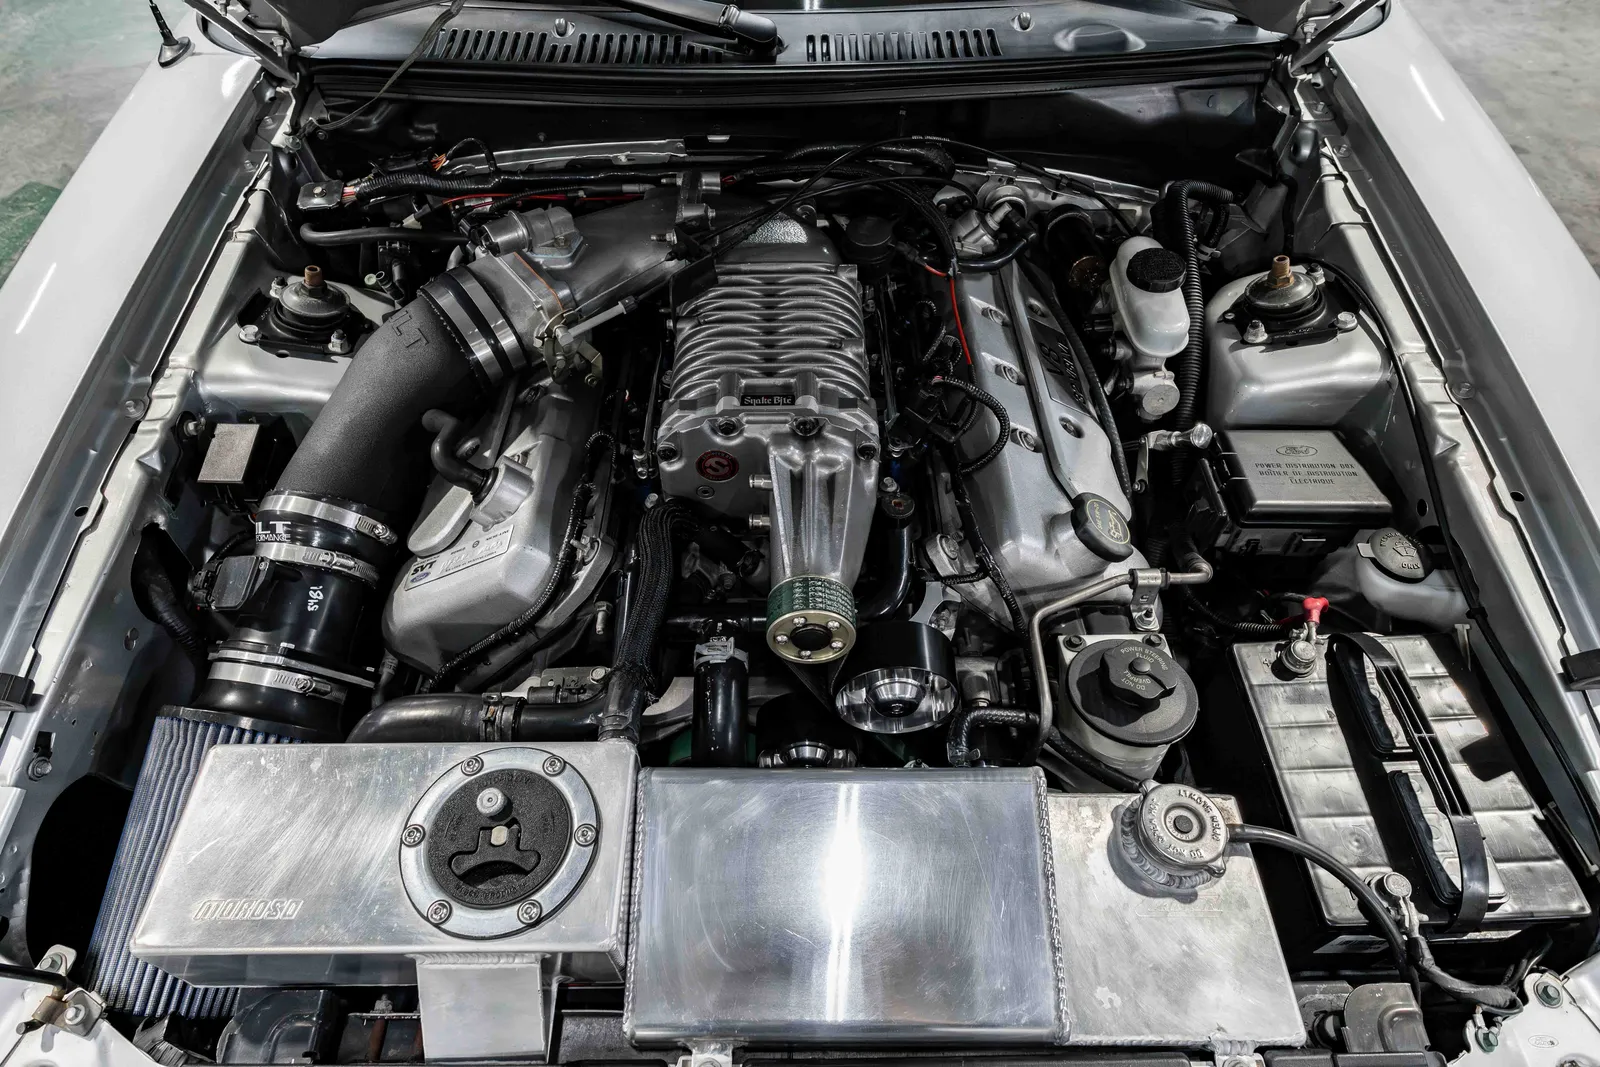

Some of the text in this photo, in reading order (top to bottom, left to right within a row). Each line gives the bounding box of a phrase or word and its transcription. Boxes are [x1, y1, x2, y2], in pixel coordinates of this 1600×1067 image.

[1039, 342, 1064, 376] V8
[411, 560, 437, 576] SVT
[1120, 646, 1169, 671] POWER STEERING
[1135, 652, 1155, 663] FLUID
[1121, 677, 1135, 687] NOT
[1123, 670, 1152, 684] OVERFILL
[1189, 848, 1205, 859] DO
[192, 898, 304, 921] MOROSO
